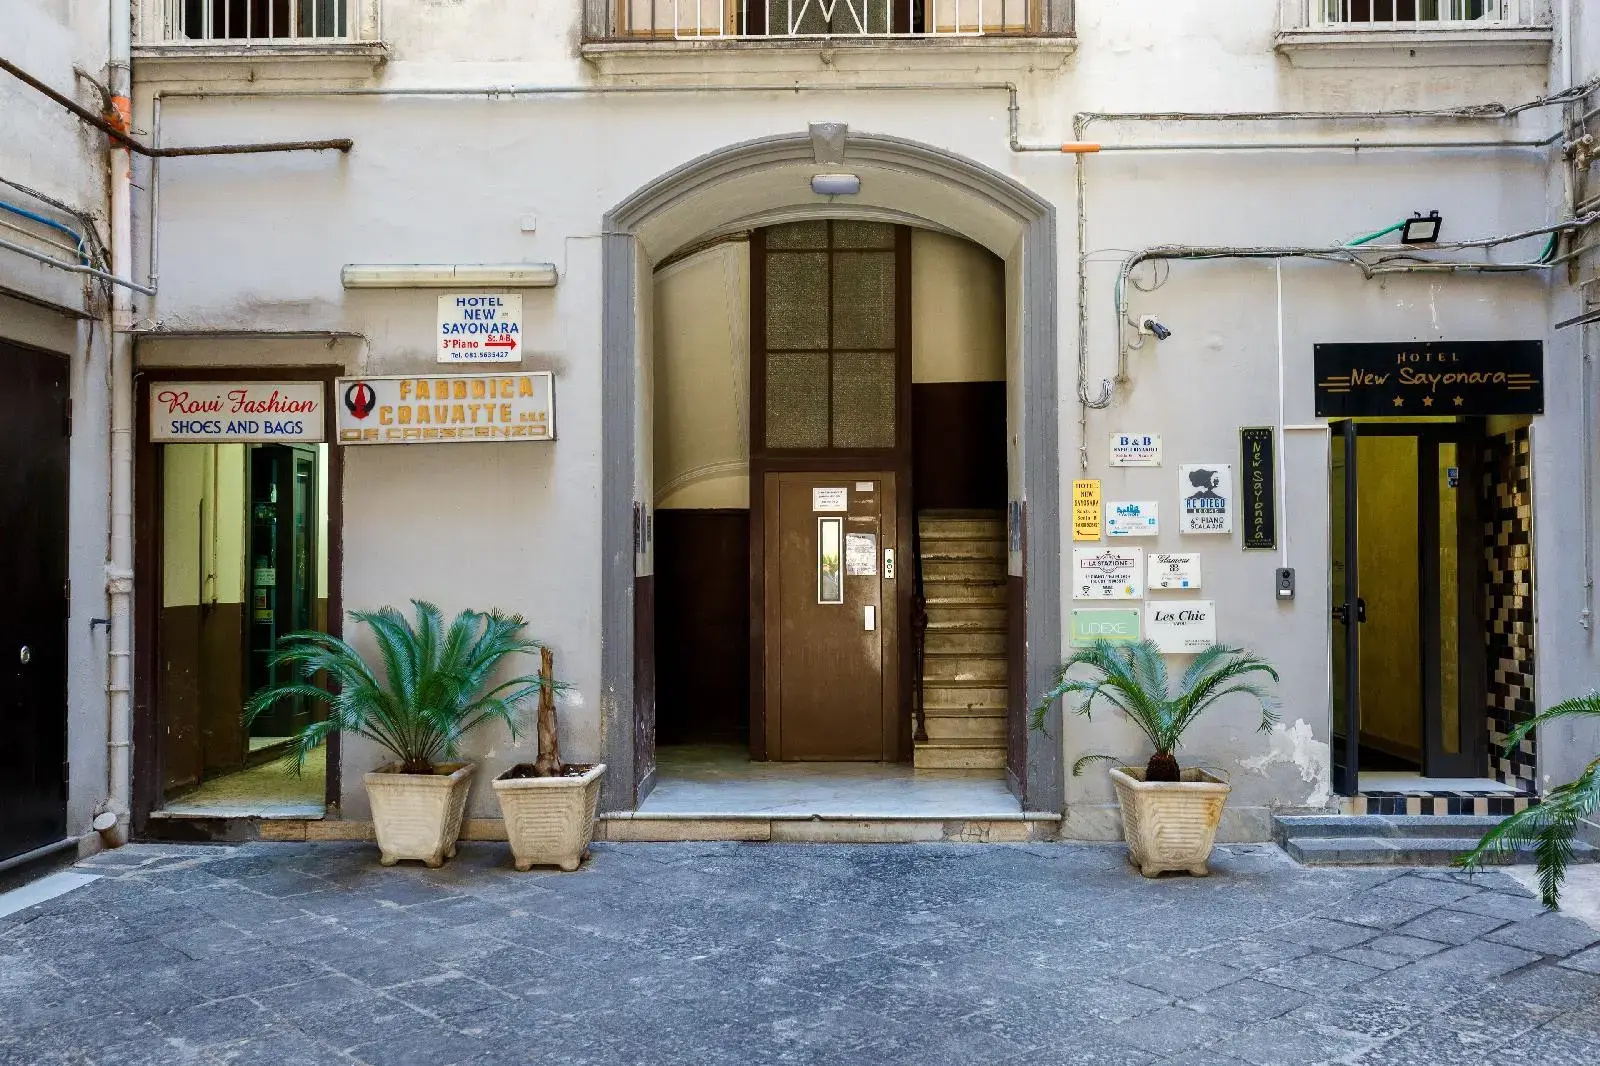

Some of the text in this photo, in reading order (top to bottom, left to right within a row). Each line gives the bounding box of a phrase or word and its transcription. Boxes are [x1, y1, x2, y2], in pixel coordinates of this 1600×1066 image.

[456, 297, 504, 306] HOTEL
[464, 309, 496, 320] NEW
[442, 322, 519, 334] SAYONARA
[453, 339, 480, 349] Piano
[1397, 353, 1459, 364] HOTEL
[1351, 367, 1508, 393] New Sayonara
[157, 389, 319, 414] Rovi Fashion
[379, 403, 513, 426] CRAVATTE
[171, 420, 303, 434] SHOES AND BAGS
[1120, 436, 1152, 446] B & B
[1200, 498, 1225, 508] DIEGO
[1201, 516, 1224, 524] PIANO
[1154, 610, 1206, 622] Les Chic
